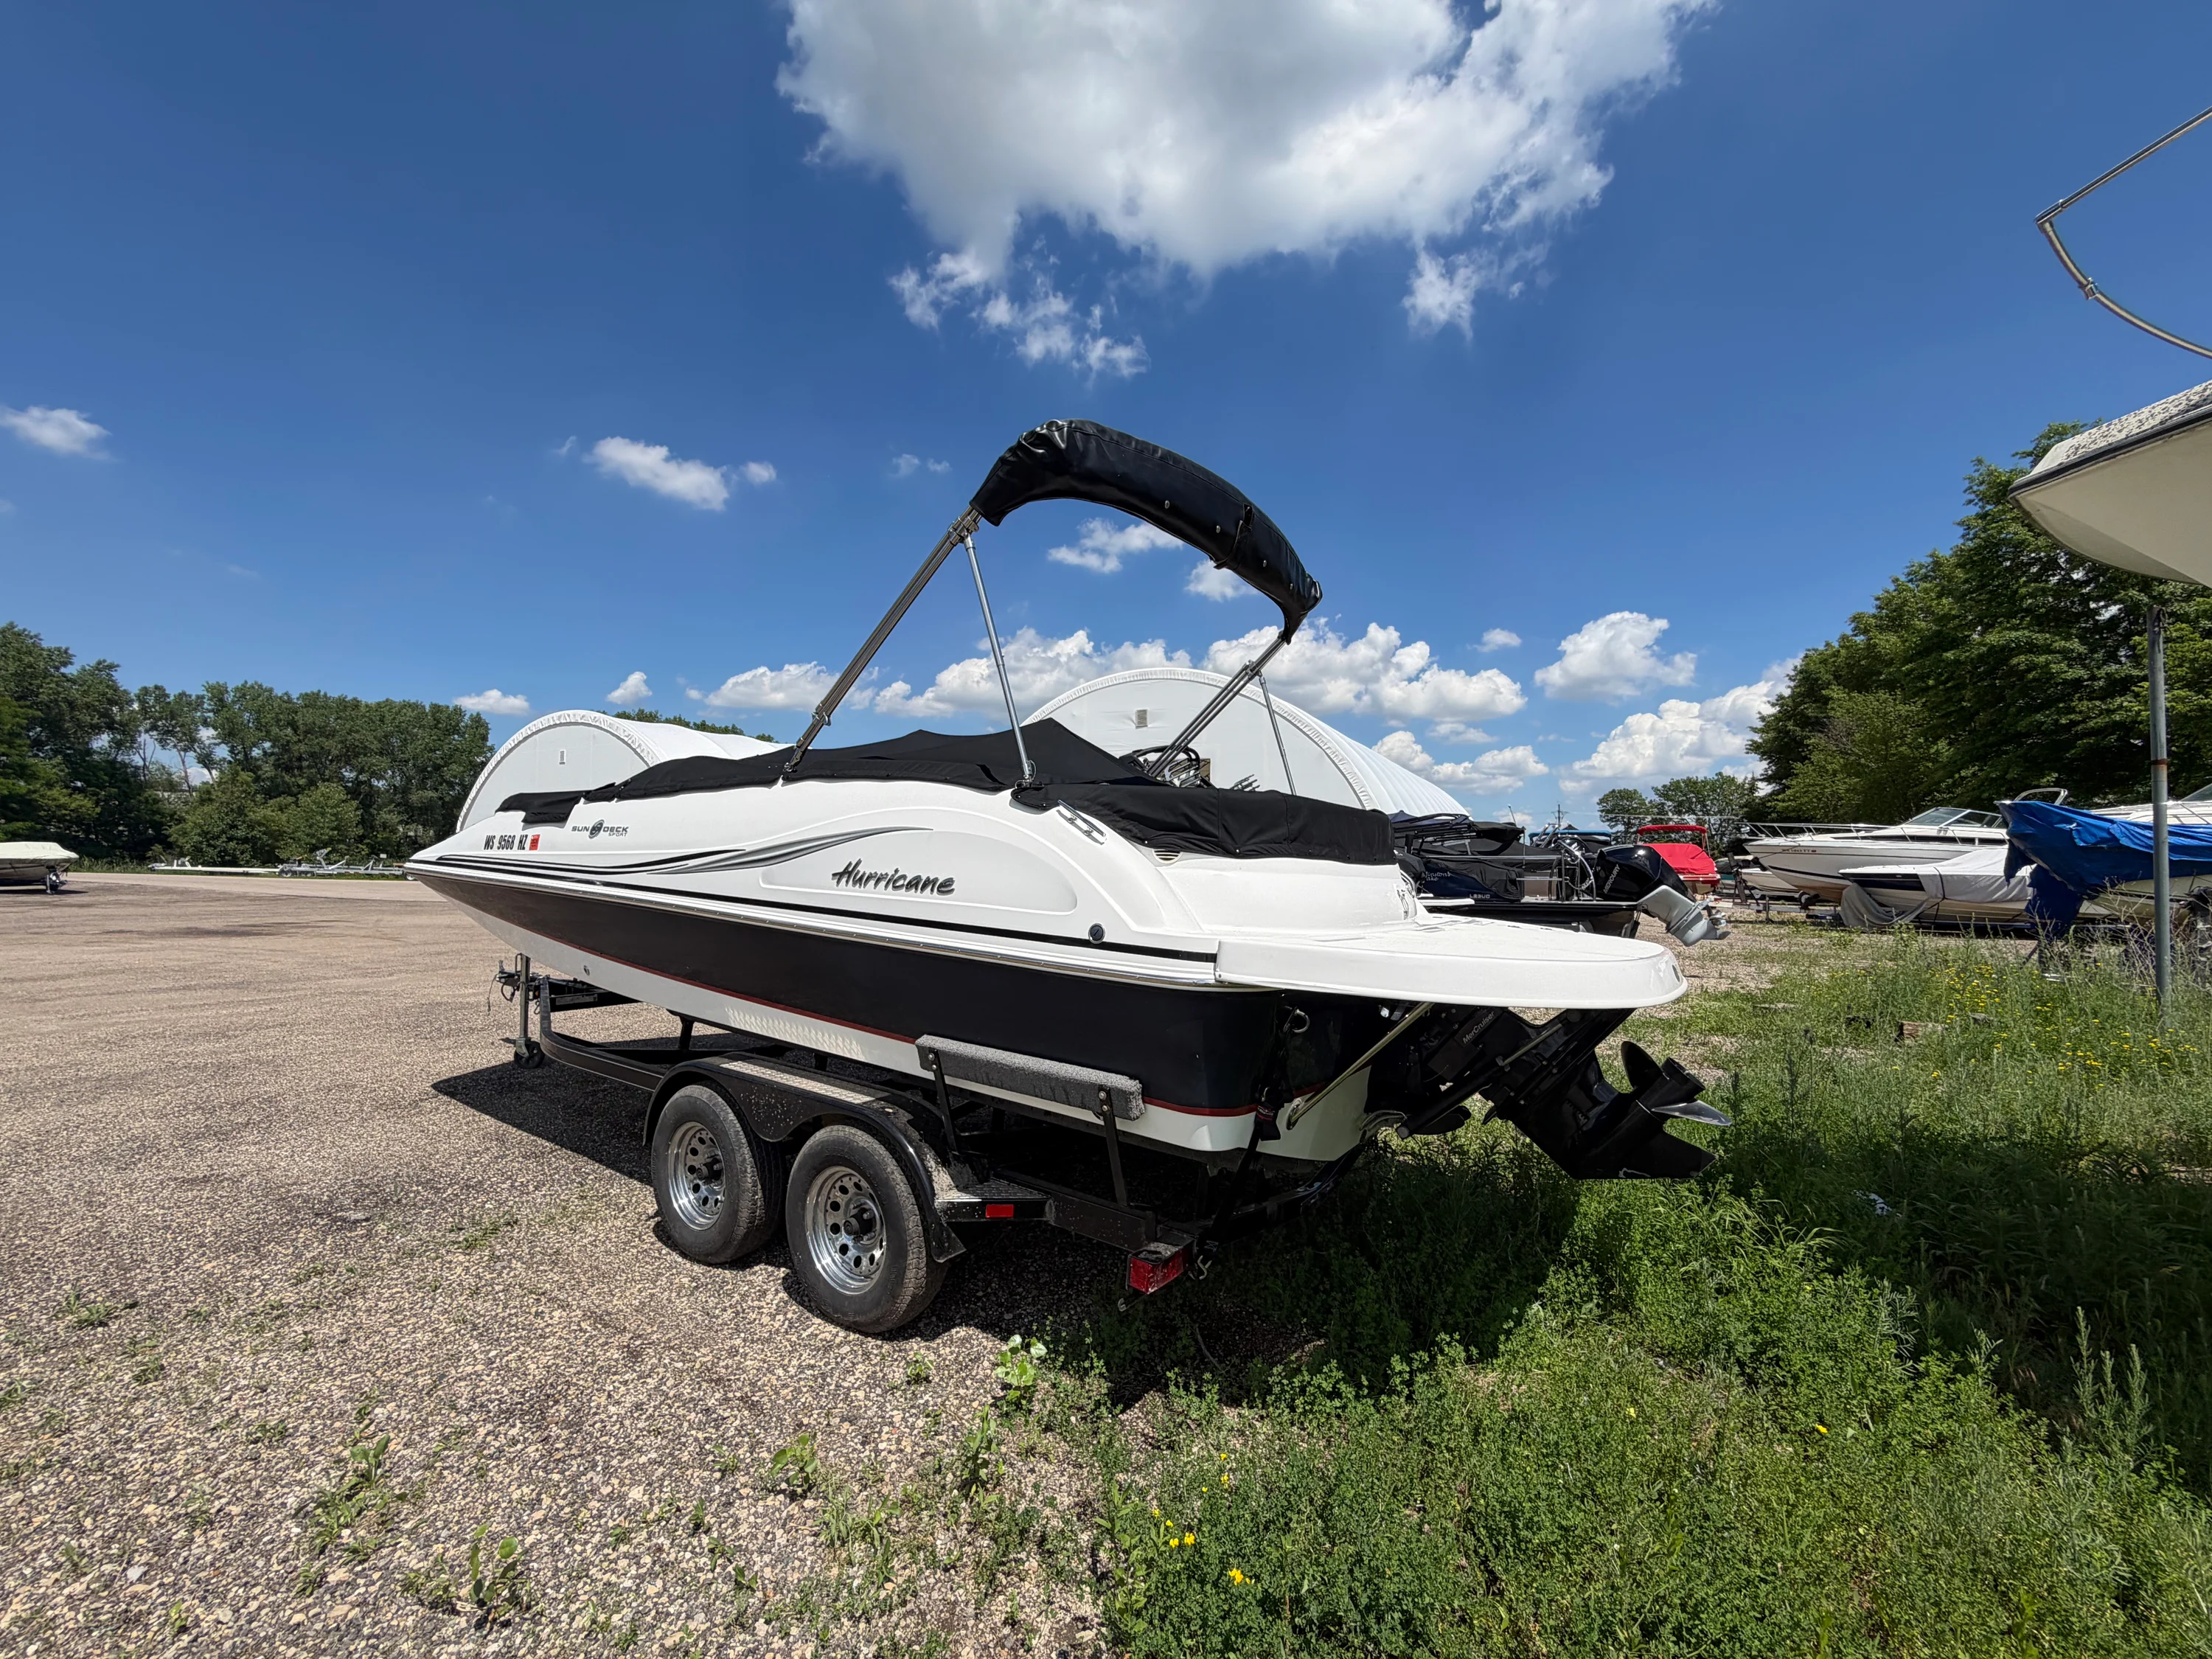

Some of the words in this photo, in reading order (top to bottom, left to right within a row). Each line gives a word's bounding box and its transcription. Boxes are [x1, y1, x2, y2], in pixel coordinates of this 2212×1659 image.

[484, 835, 495, 851] WS
[497, 835, 516, 851] 9568
[517, 834, 529, 851] HZ
[832, 858, 956, 897] Hurricane
[1603, 863, 1621, 894] MERCURY
[1462, 1011, 1495, 1044] MerCruiser
